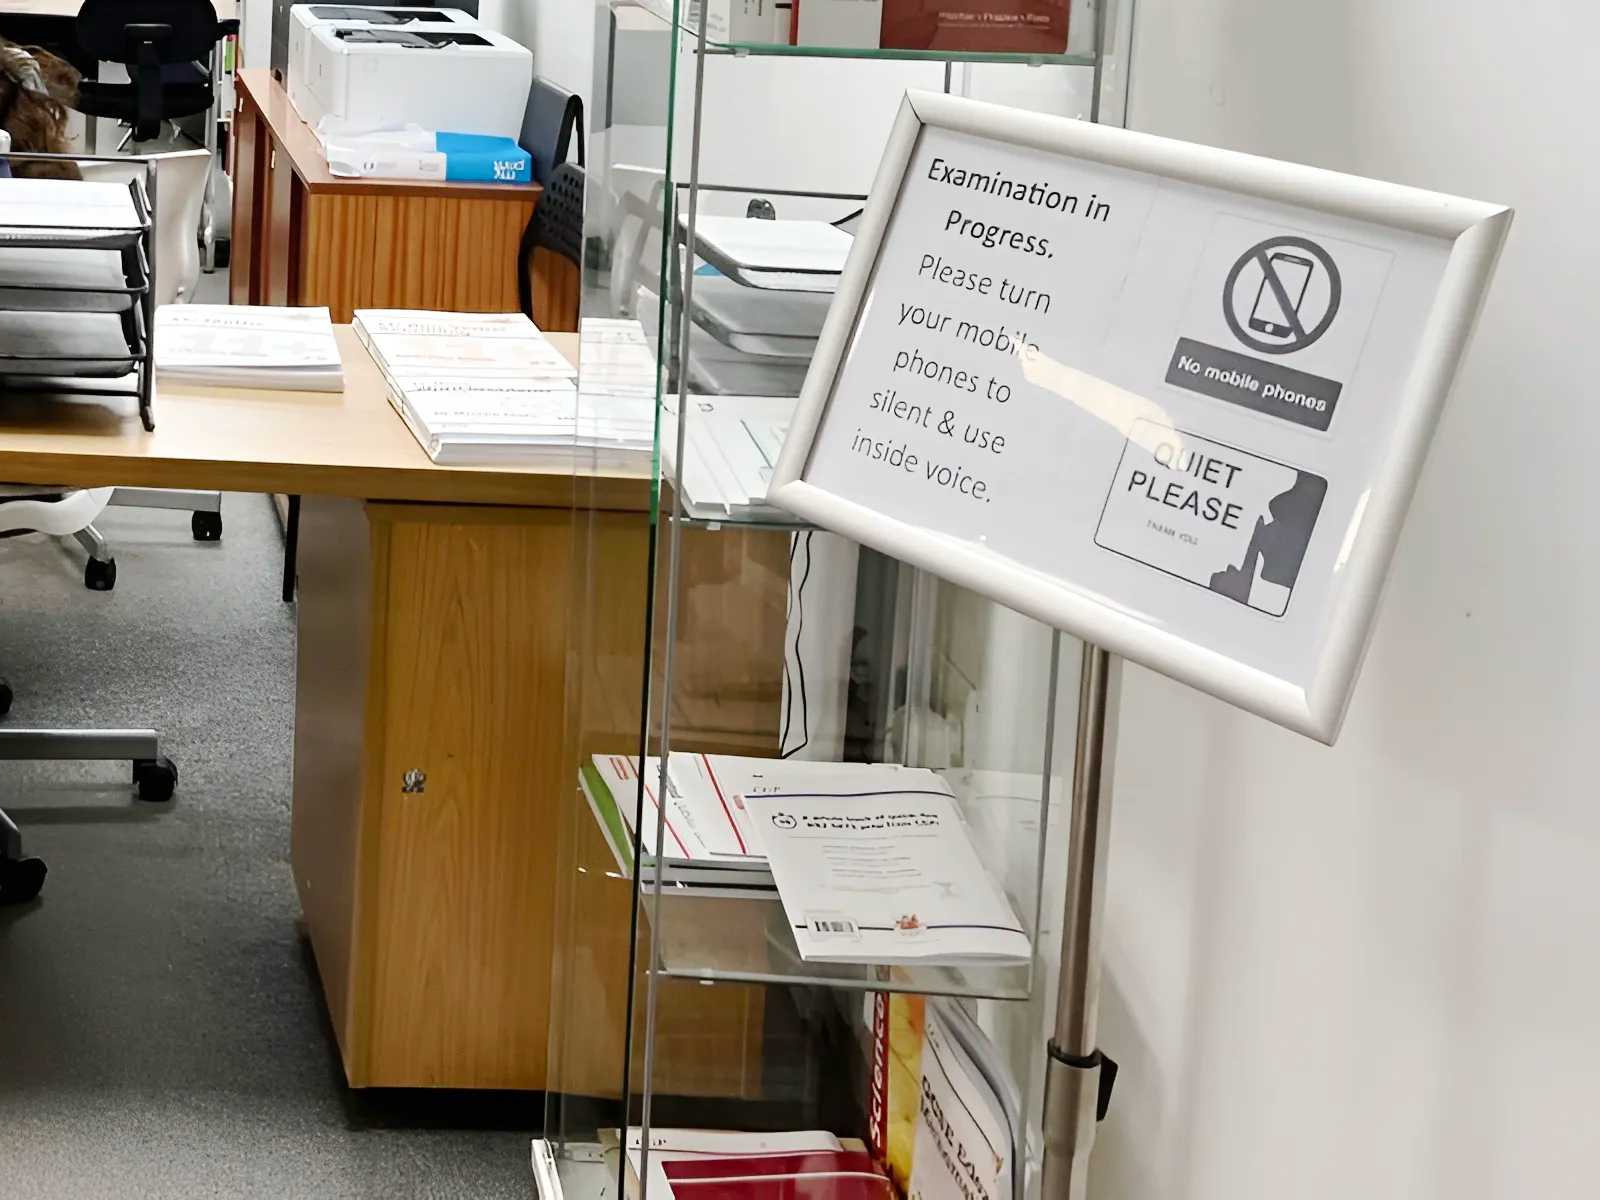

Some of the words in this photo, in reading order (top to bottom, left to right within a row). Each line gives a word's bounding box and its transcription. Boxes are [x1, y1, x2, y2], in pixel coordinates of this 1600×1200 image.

[927, 157, 1079, 214] Examination
[1085, 194, 1111, 222] in
[944, 210, 1054, 259] Progress.
[918, 254, 992, 295] Please
[999, 278, 1051, 314] turn
[898, 303, 952, 333] your
[956, 326, 1040, 361] mobile
[893, 348, 980, 393] phones
[987, 376, 1011, 403] to
[1177, 355, 1201, 374] No
[1204, 366, 1260, 392] mobile
[1261, 383, 1327, 412] phones
[869, 389, 932, 428] silent
[937, 410, 955, 437] &
[964, 424, 1006, 454] use
[851, 428, 918, 473] inside
[926, 460, 991, 503] voice.
[1154, 442, 1243, 489] QUIET
[1127, 470, 1243, 530] PLEASE
[870, 993, 885, 1148] Science
